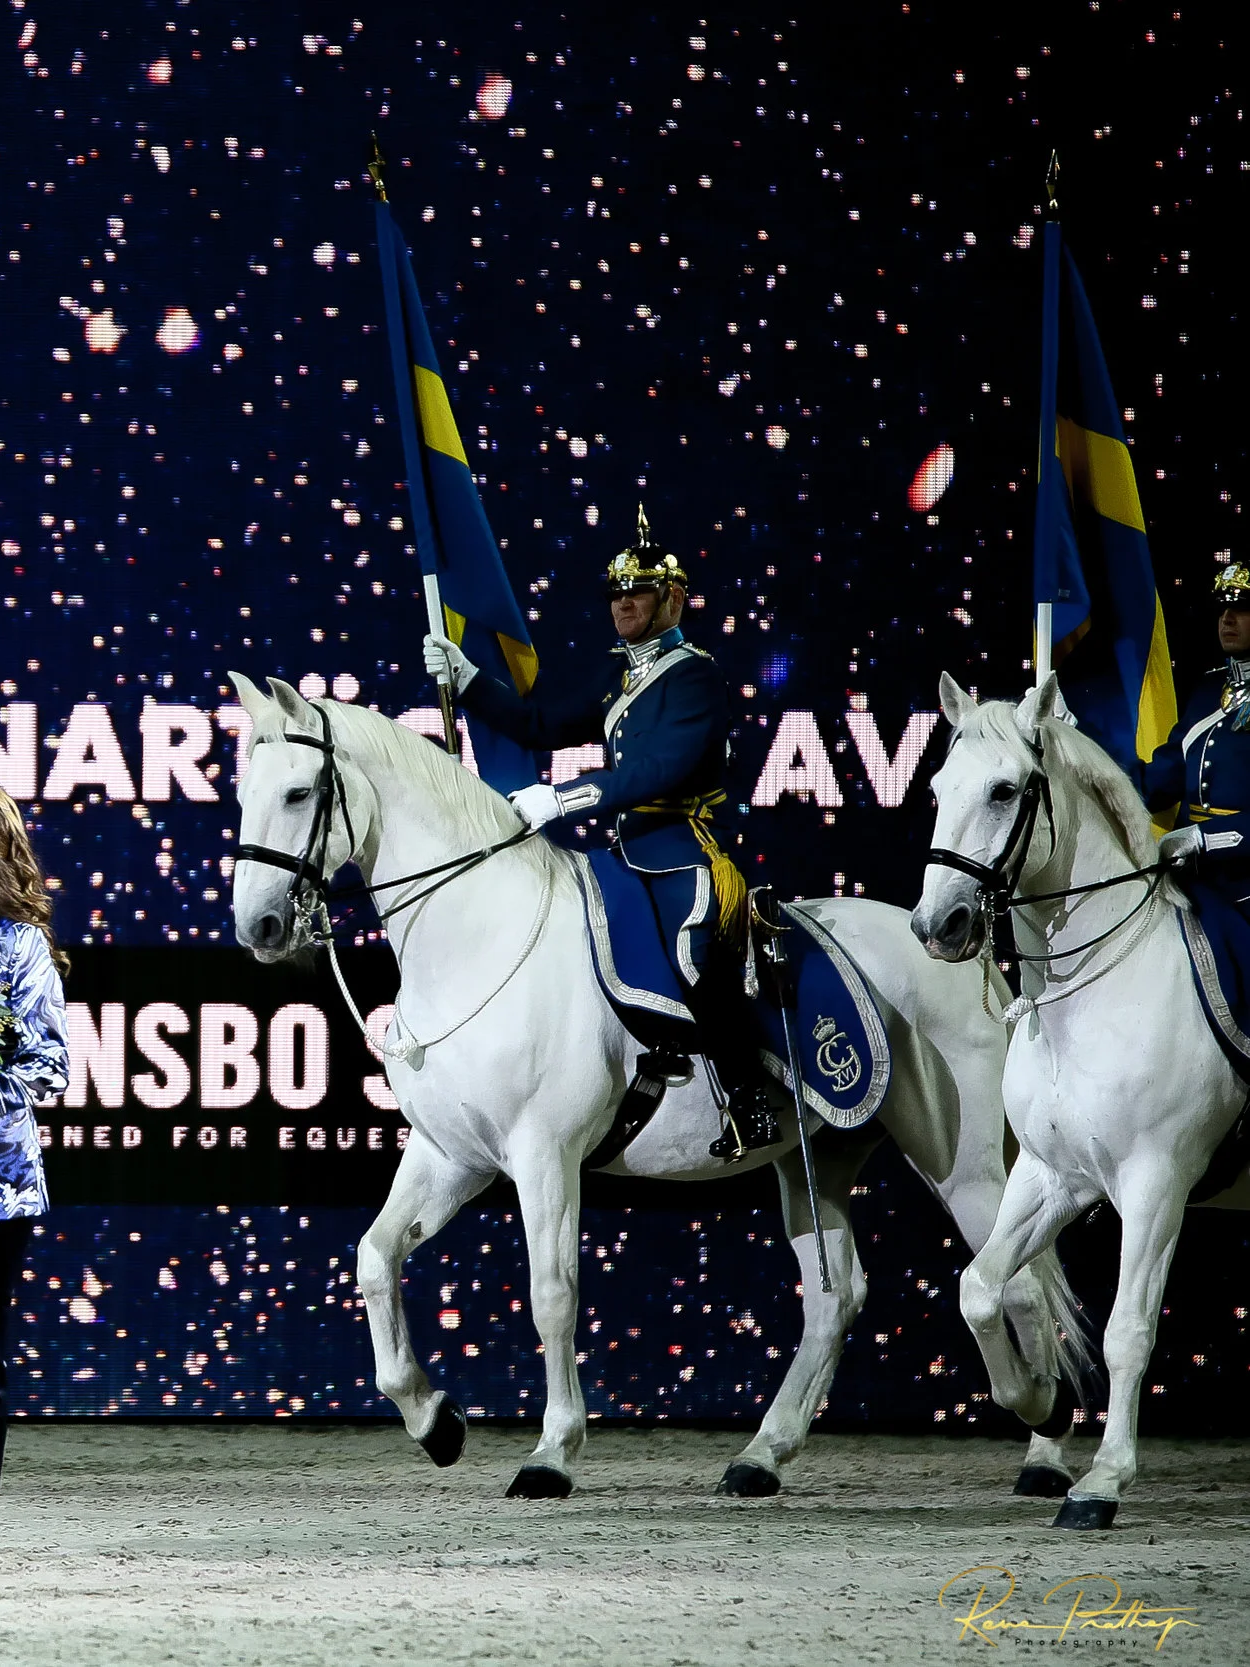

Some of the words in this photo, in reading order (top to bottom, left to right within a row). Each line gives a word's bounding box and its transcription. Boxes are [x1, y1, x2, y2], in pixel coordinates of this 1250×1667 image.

[751, 711, 938, 807] AV
[35, 1002, 328, 1110] NSBO
[37, 1125, 142, 1149] GNED
[173, 1126, 246, 1149] FOR
[278, 1127, 411, 1150] EQUES
